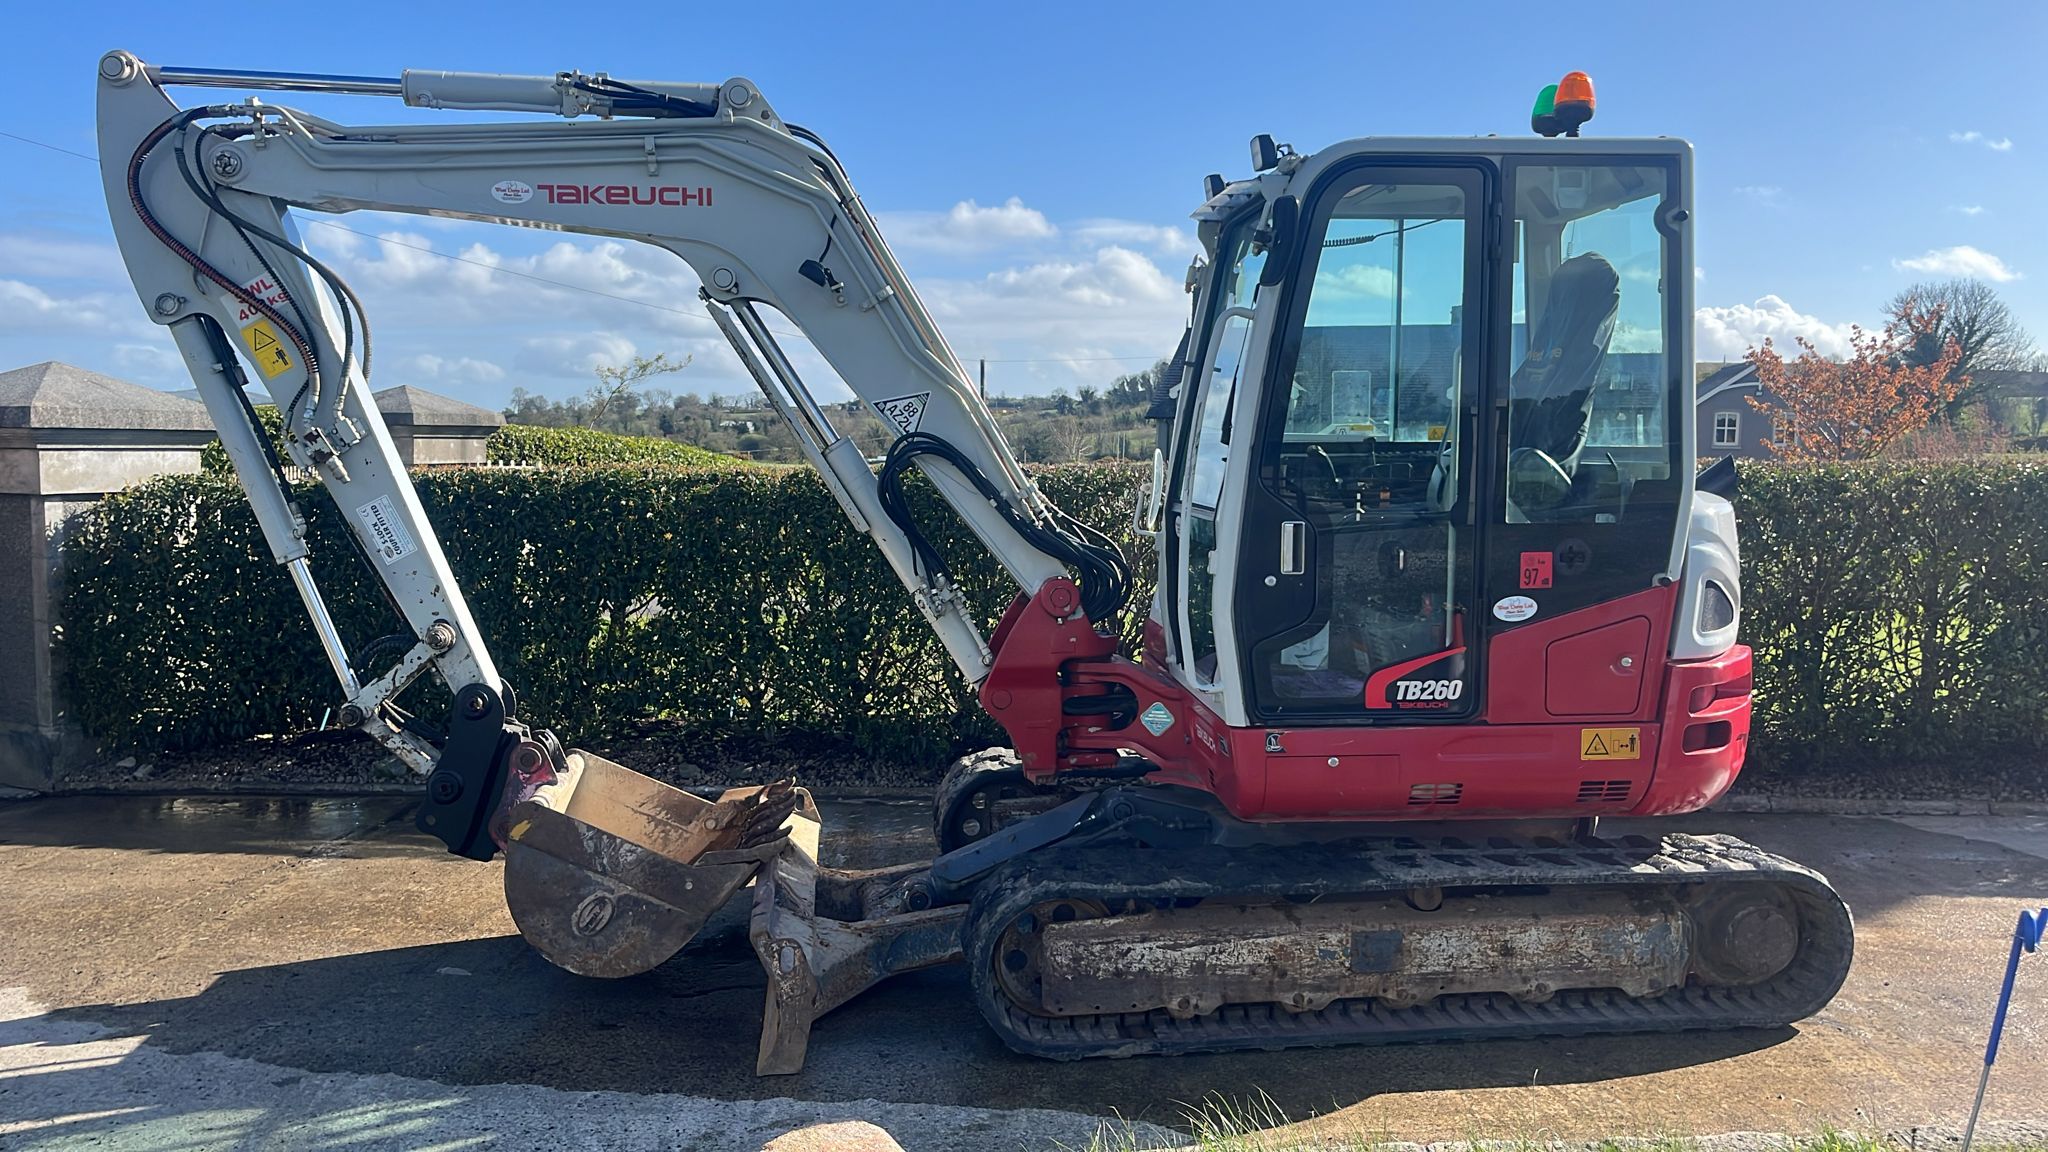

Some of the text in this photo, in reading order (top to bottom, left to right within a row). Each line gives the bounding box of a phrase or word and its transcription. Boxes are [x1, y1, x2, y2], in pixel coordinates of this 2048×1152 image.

[537, 184, 713, 206] TAKEUCHI
[903, 401, 919, 418] 88
[371, 505, 387, 527] FITTED
[372, 521, 388, 545] S-LOCK
[383, 527, 403, 555] COUPLER
[1524, 568, 1539, 585] 97
[1397, 680, 1463, 700] TB260
[1397, 701, 1449, 709] TAKEUCHI
